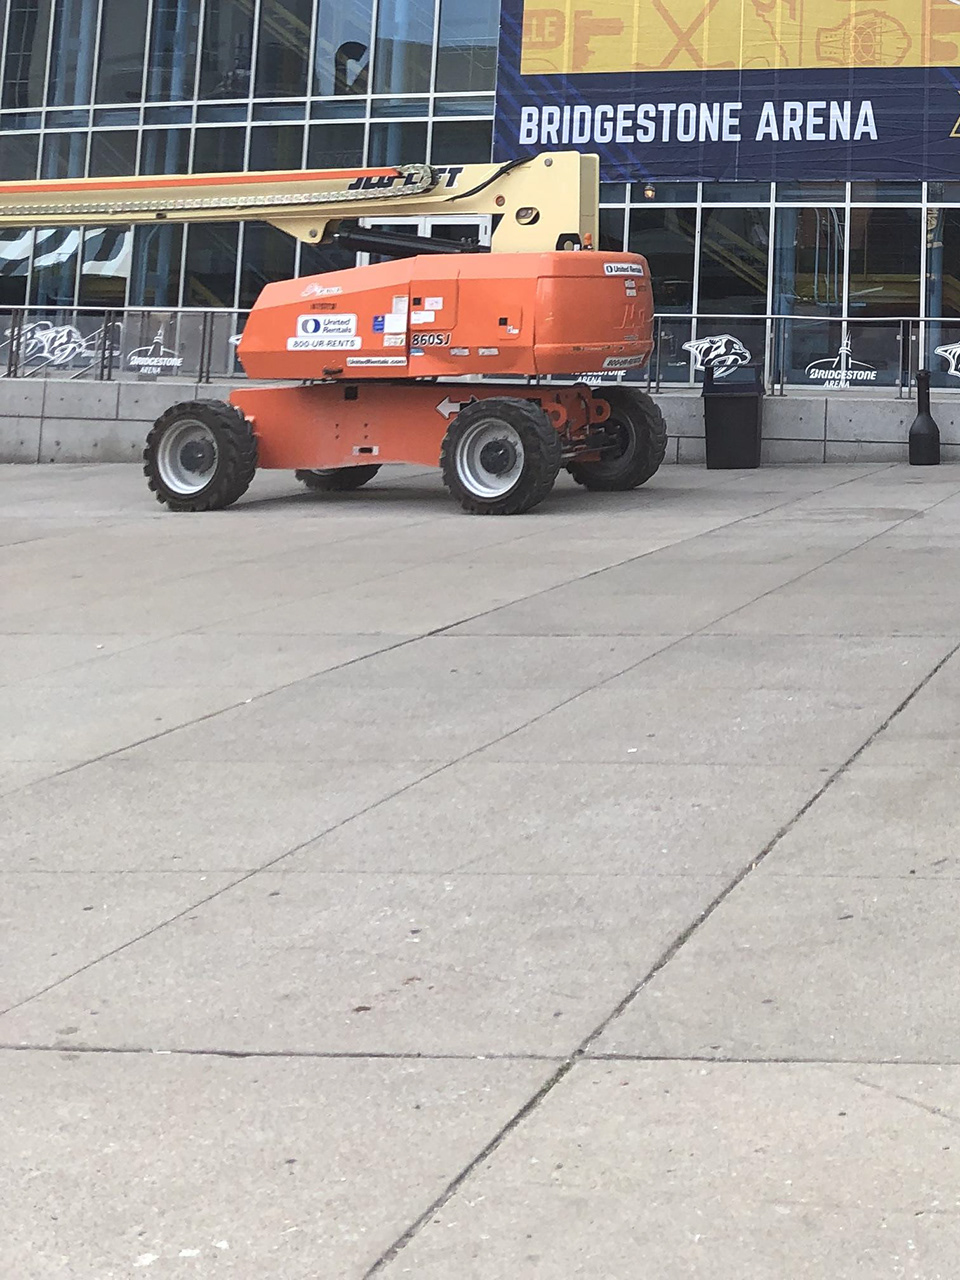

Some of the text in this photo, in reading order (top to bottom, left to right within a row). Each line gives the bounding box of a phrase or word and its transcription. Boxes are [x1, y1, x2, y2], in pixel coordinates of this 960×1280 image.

[518, 99, 879, 146] BRIDGESTONE ARENA
[323, 318, 352, 326] United
[411, 333, 451, 346] 860SJ
[129, 356, 184, 367] BRIDGESTONE
[808, 368, 877, 380] BRIDGESTONE
[576, 376, 602, 384] ARENA
[822, 379, 851, 388] ARENA
